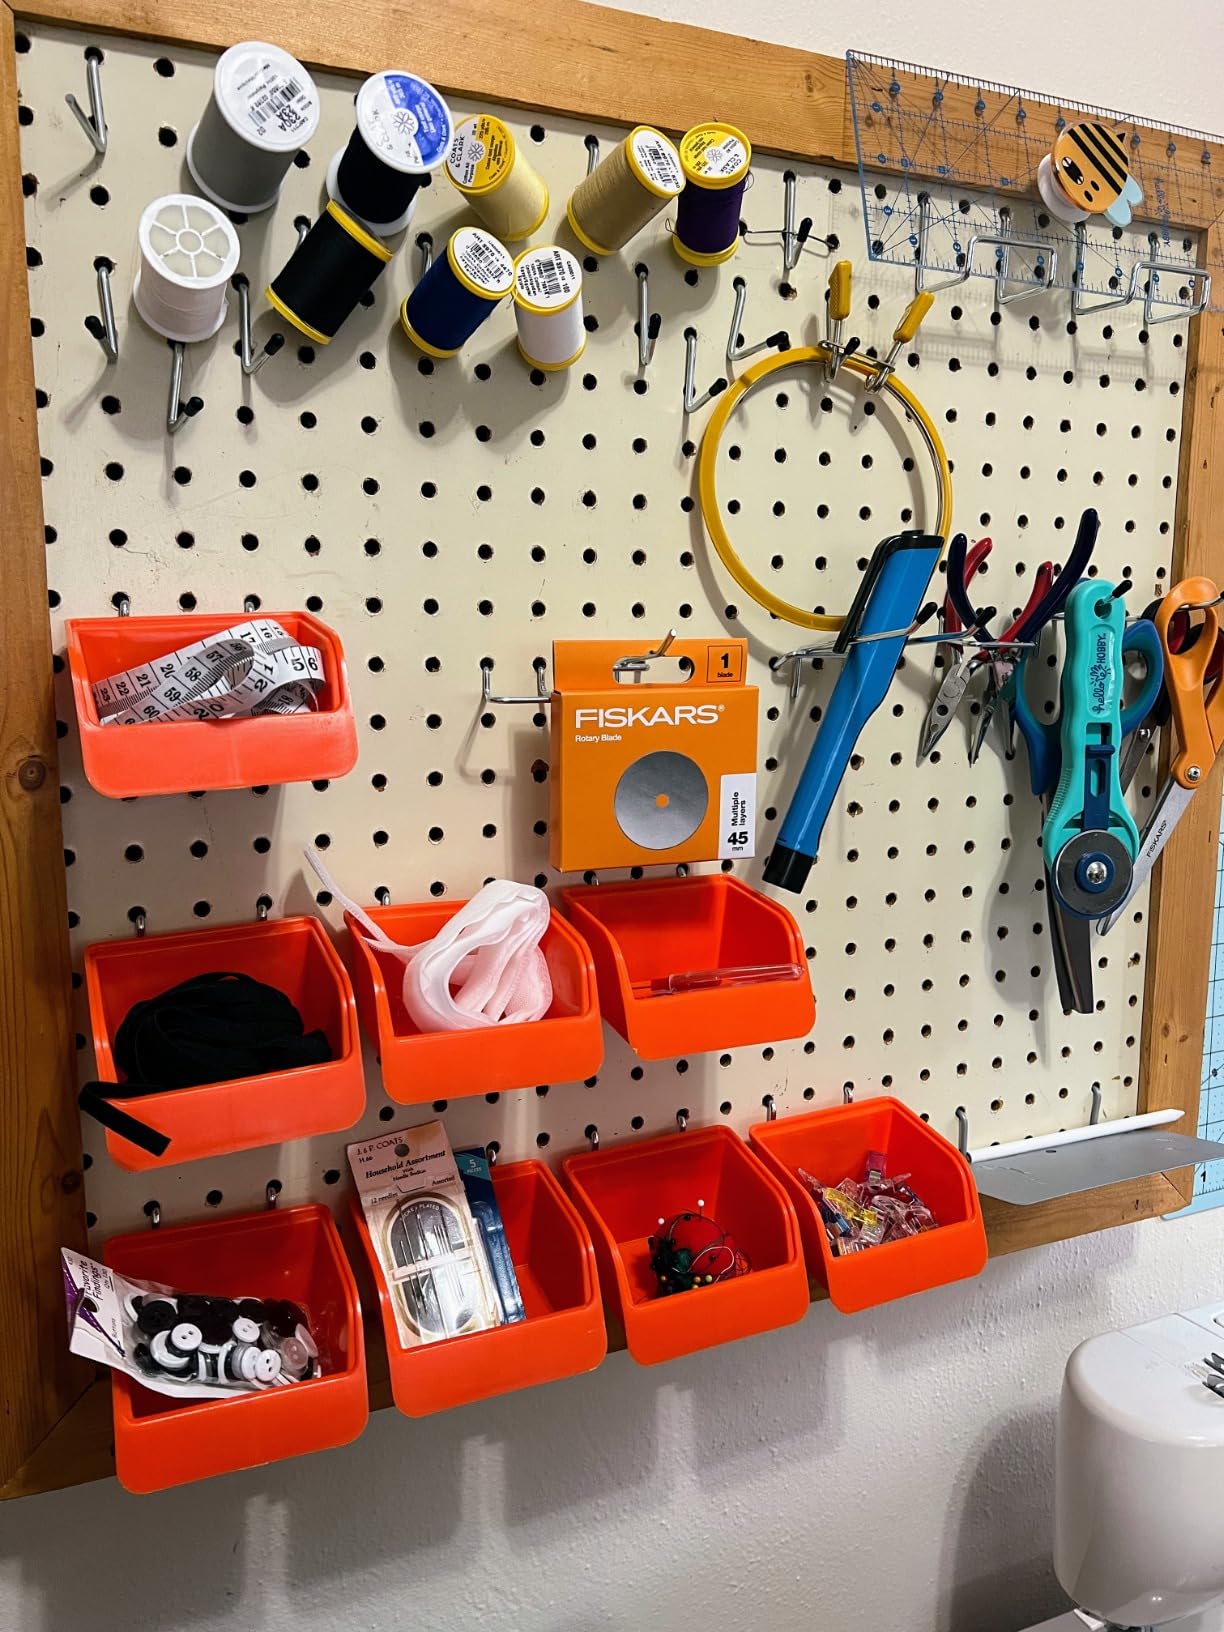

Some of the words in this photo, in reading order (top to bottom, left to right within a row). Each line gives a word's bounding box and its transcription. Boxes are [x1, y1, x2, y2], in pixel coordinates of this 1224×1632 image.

[450, 138, 459, 163] COATS
[456, 136, 465, 161] CLARK
[553, 250, 562, 261] ART
[260, 627, 273, 638] 16
[1096, 634, 1106, 663] HOBBY
[205, 650, 224, 662] 57
[720, 652, 730, 669] 1
[136, 674, 152, 688] 21
[184, 667, 202, 682] 58
[101, 688, 110, 702] 23
[116, 682, 130, 696] 22
[164, 686, 182, 702] 59
[1092, 680, 1105, 713] hello
[144, 705, 160, 718] 60
[575, 734, 600, 743] Rotary
[731, 792, 740, 826] Multiple
[728, 832, 748, 845] 45
[376, 1137, 402, 1149] COATS
[366, 1162, 404, 1178] Household
[406, 1151, 446, 1166] Assortment
[468, 1158, 476, 1168] 5
[432, 1175, 455, 1185] Assorted
[1200, 1170, 1206, 1183] 1
[377, 1191, 398, 1202] needles
